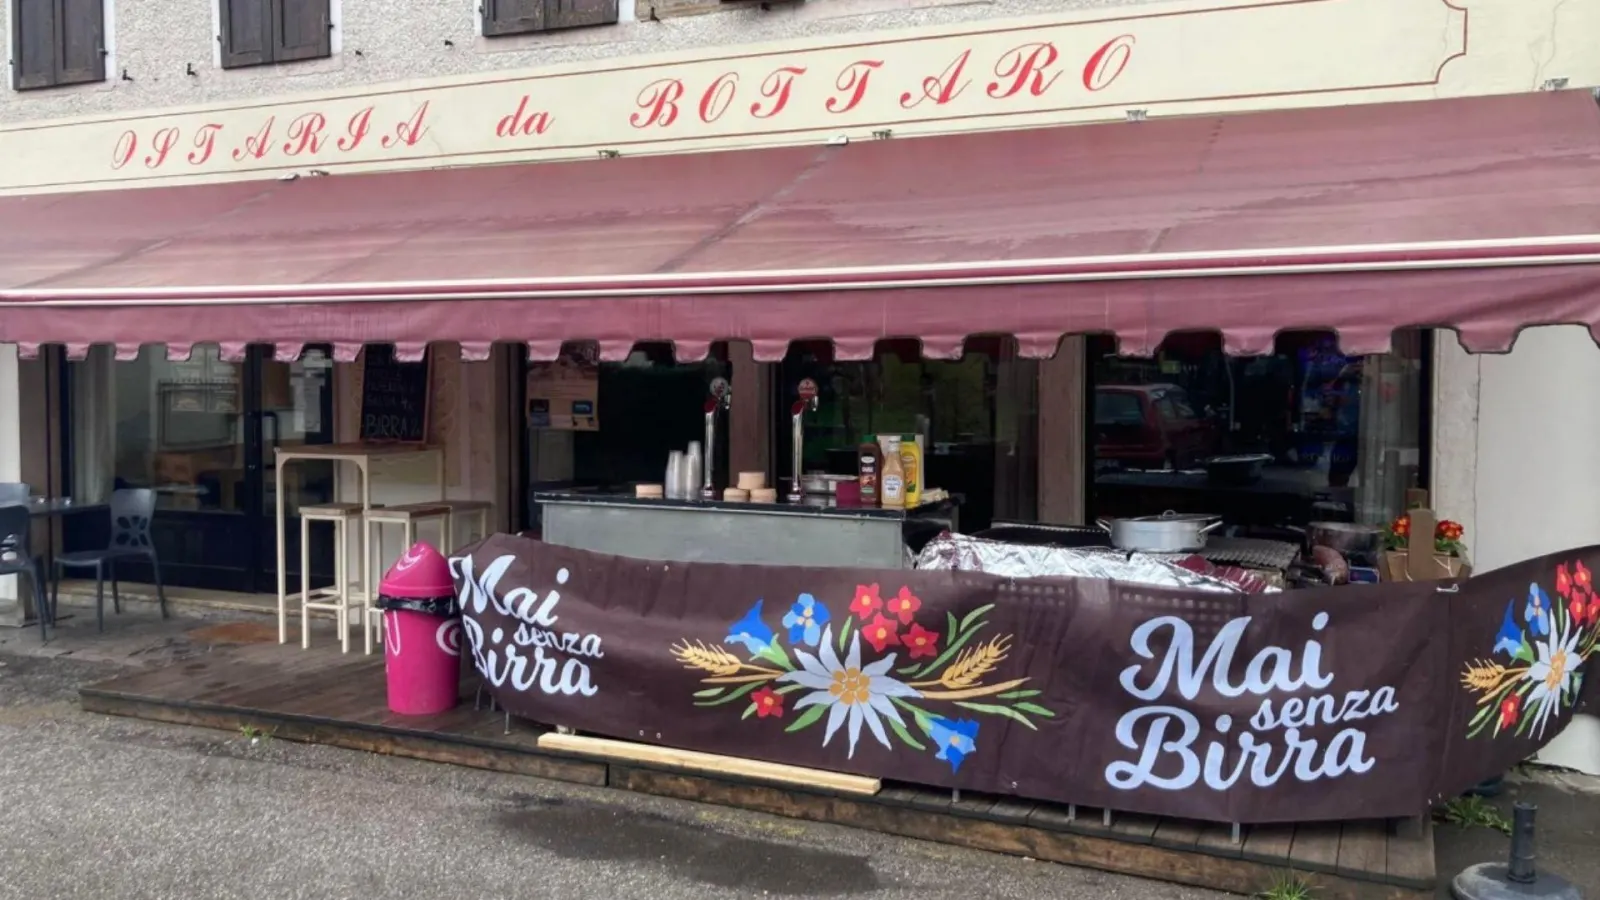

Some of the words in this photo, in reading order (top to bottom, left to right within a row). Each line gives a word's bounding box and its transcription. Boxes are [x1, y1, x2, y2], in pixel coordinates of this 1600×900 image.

[111, 100, 429, 170] OSTARIA
[496, 95, 555, 138] da
[629, 34, 1136, 128] BOTTARO
[448, 553, 570, 626] Mai
[513, 622, 604, 658] senza
[1119, 611, 1334, 700] Mai
[1104, 705, 1376, 790] Birra
[1250, 685, 1399, 731] senza
